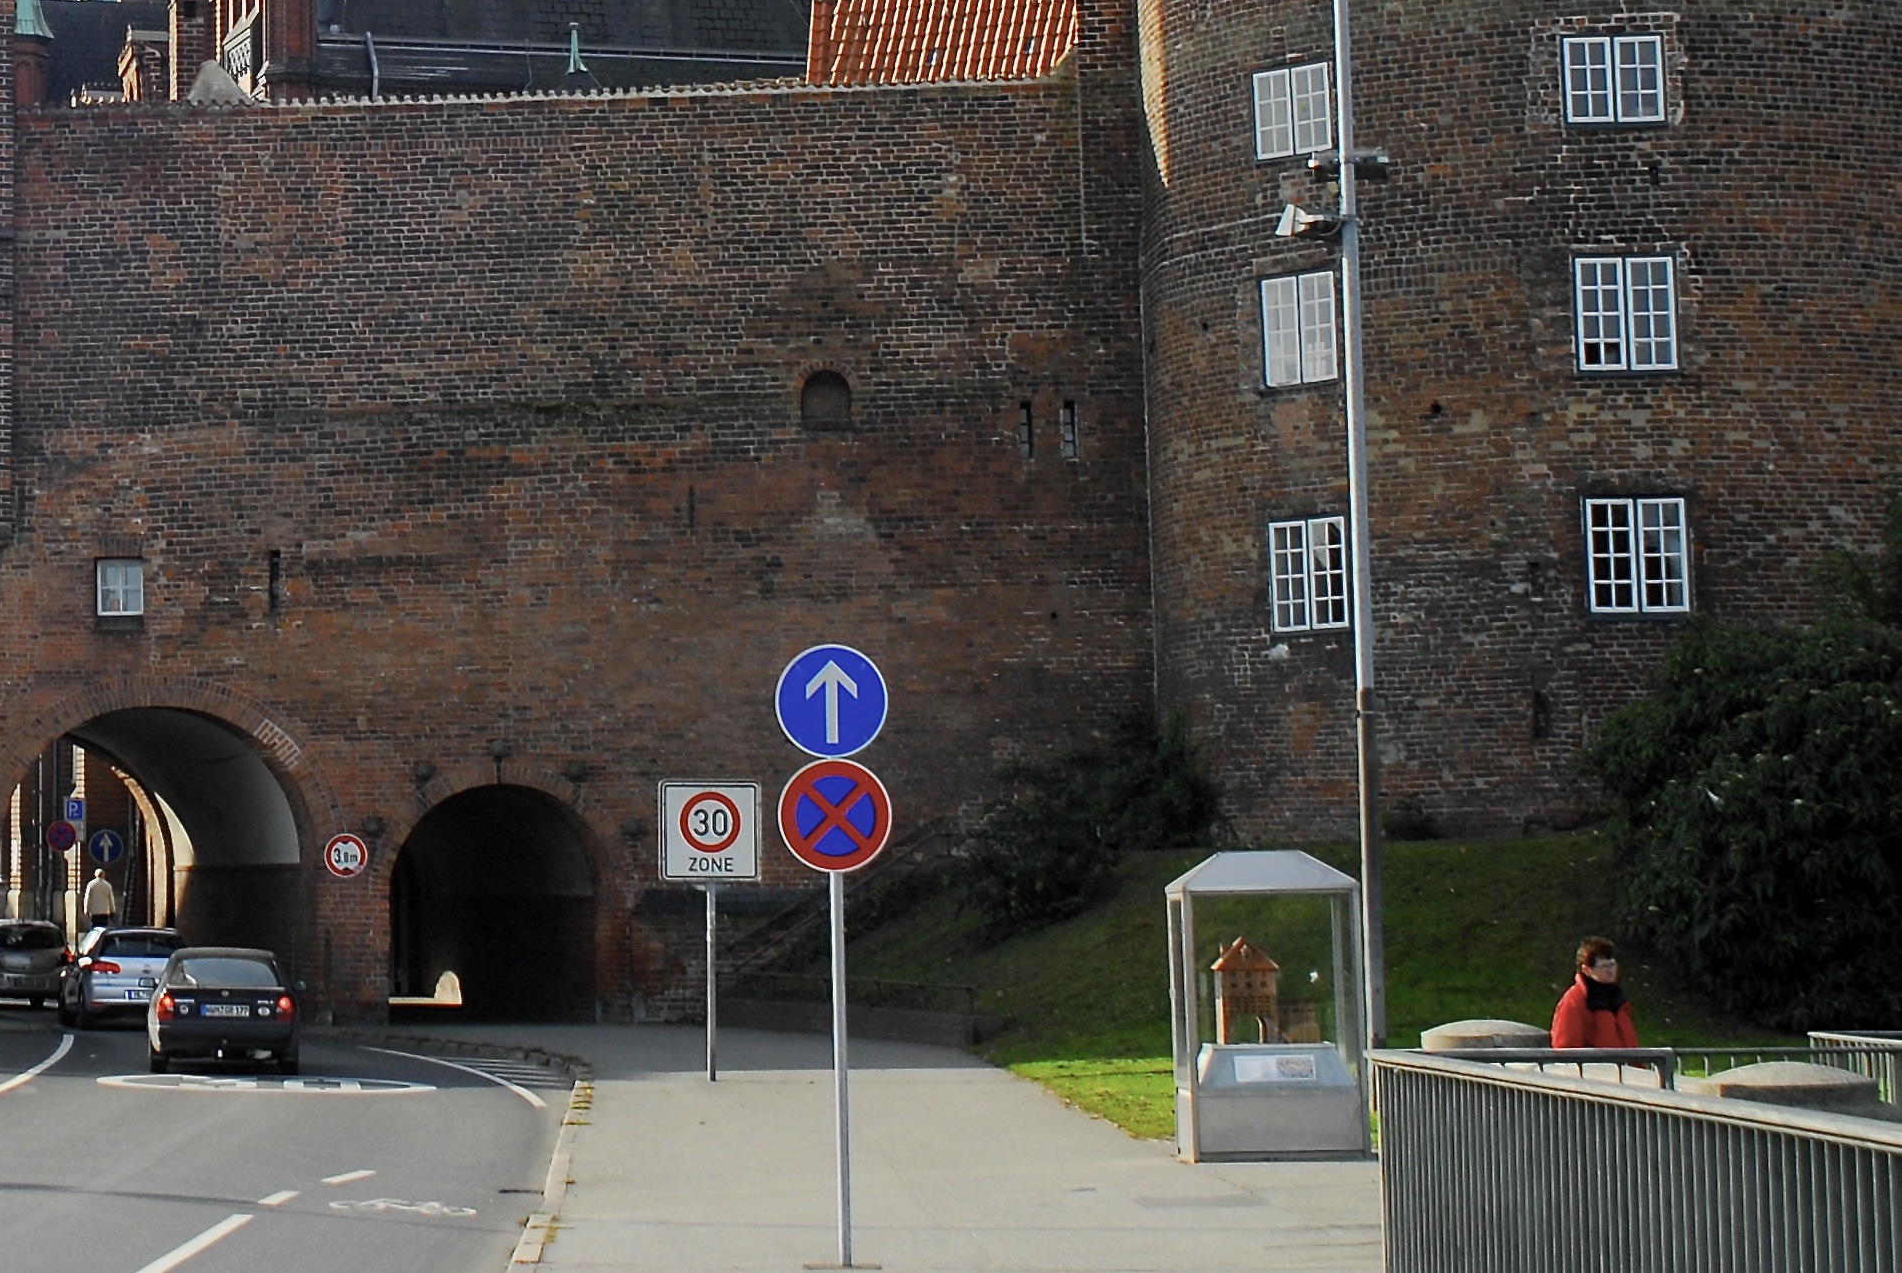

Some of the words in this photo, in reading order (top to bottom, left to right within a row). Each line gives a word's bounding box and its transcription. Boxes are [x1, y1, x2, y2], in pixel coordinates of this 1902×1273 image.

[68, 802, 78, 817] P
[693, 809, 728, 836] 30
[688, 857, 734, 873] ZONE
